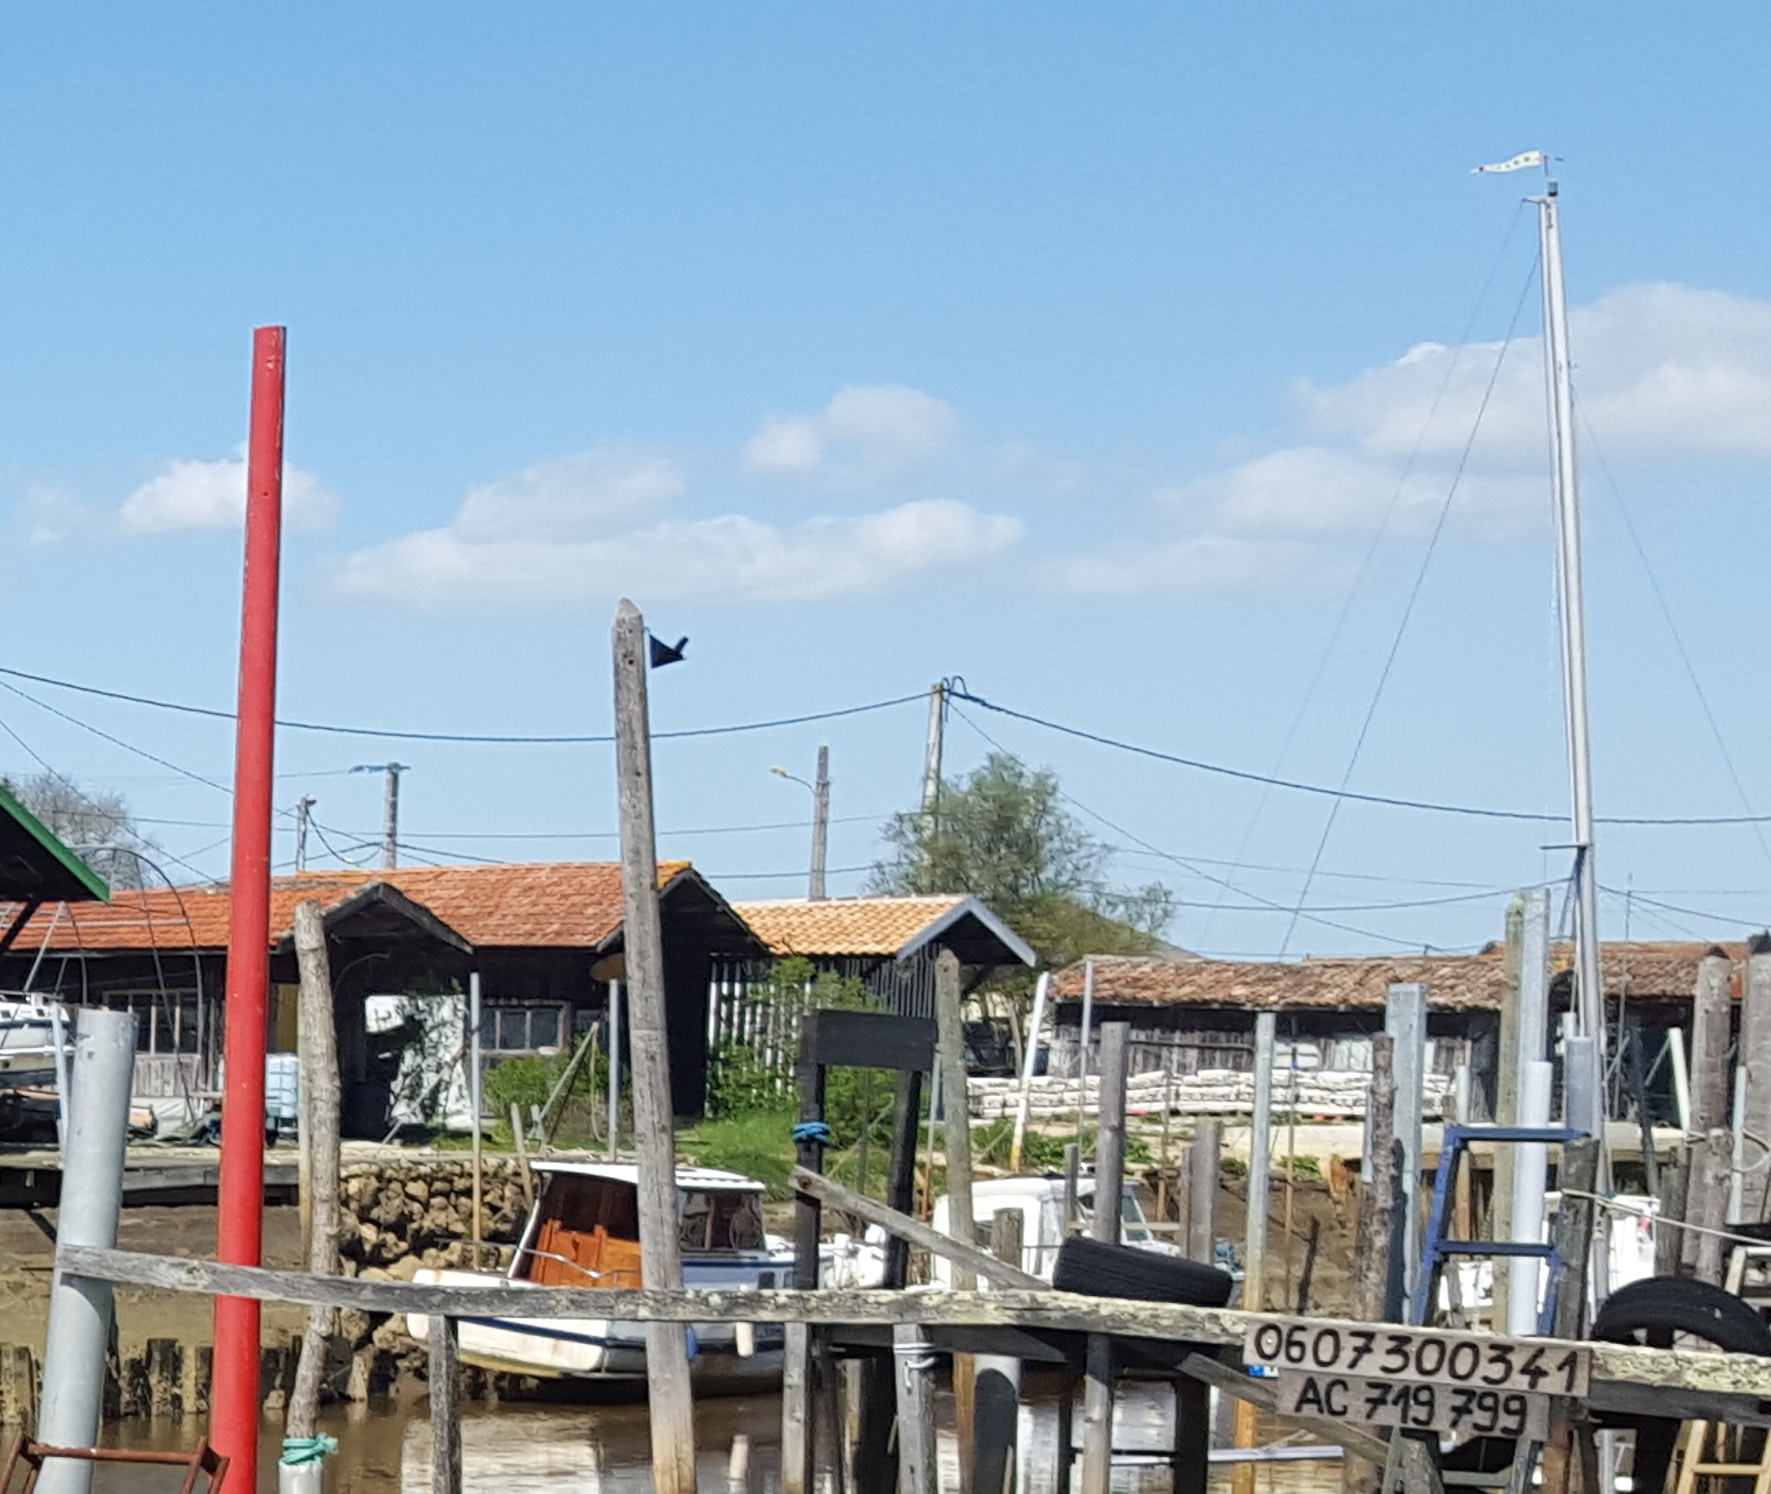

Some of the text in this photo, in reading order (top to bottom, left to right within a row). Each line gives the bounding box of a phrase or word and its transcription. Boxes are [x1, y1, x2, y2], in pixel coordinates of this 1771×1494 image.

[1254, 1322, 1578, 1393] 0607300341
[1295, 1376, 1528, 1437] AC 719 799
